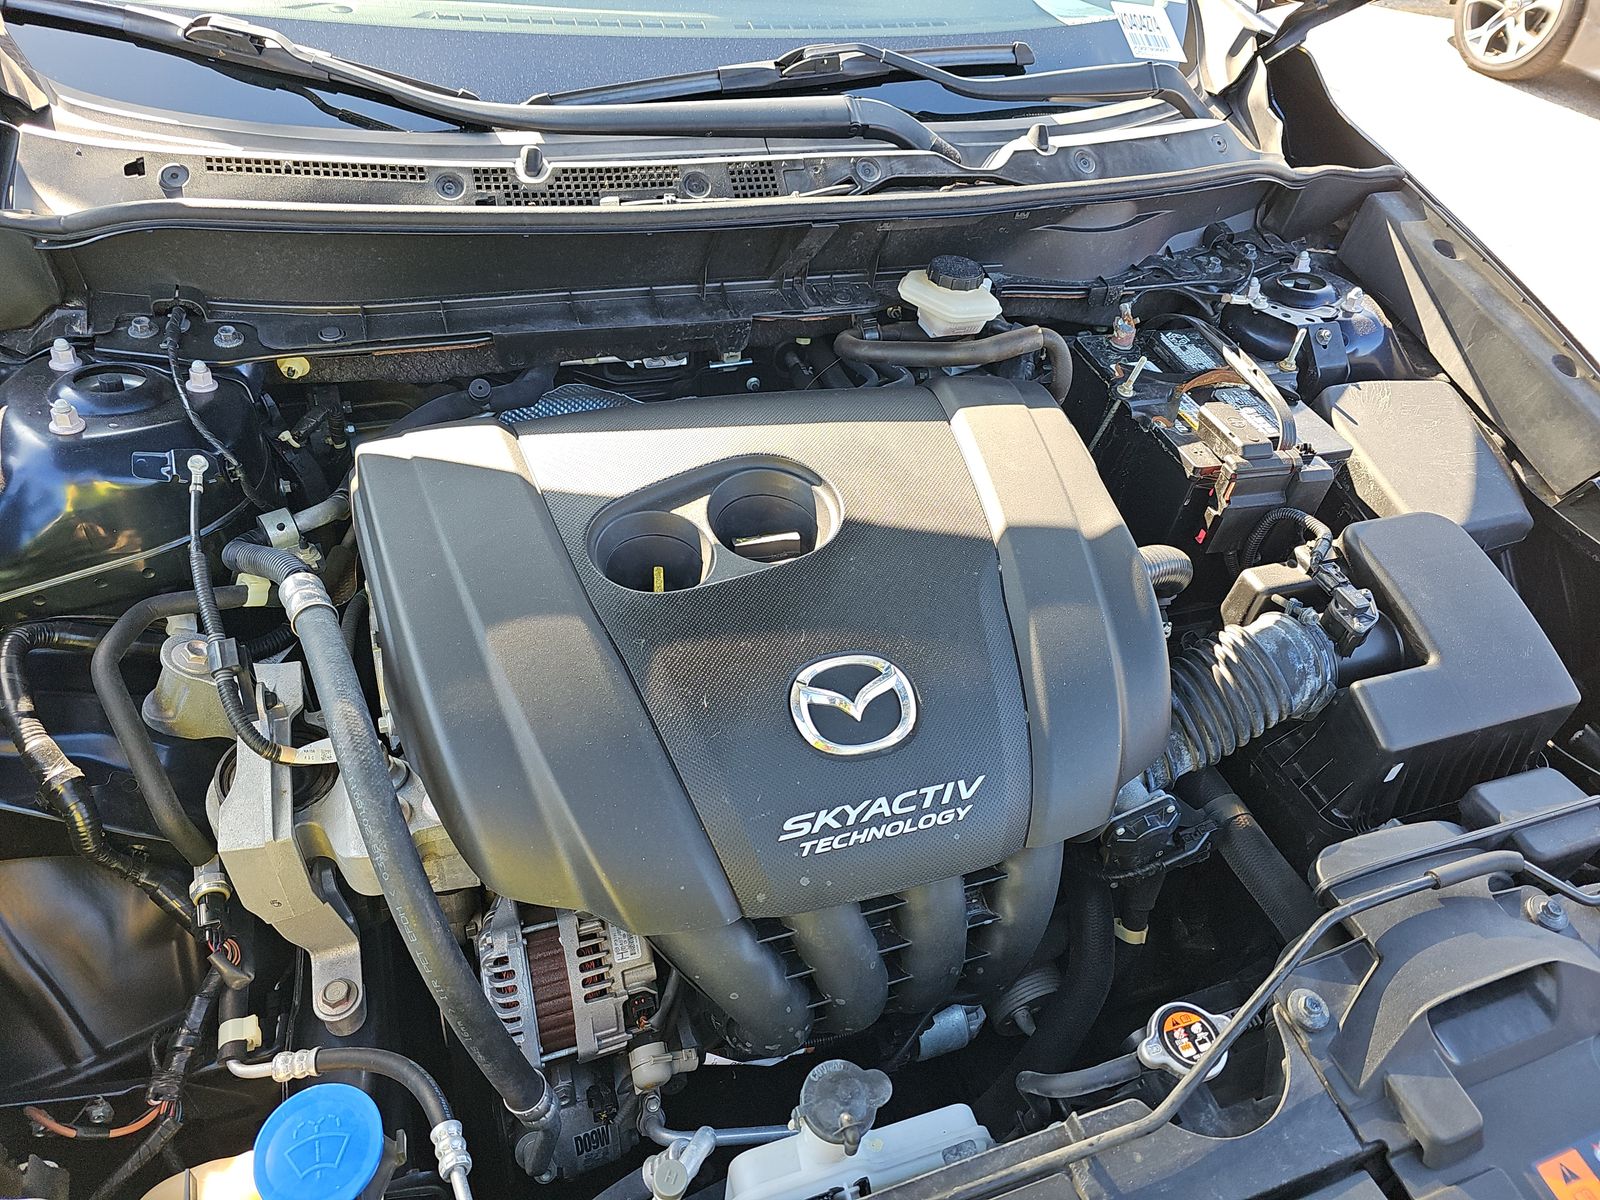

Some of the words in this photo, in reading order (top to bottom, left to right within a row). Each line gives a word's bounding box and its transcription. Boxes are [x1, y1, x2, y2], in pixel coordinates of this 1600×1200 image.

[778, 775, 986, 842] SKYACTIV
[799, 804, 974, 858] TECHNOLOGY
[396, 906, 417, 943] EPDM
[416, 950, 433, 973] PET
